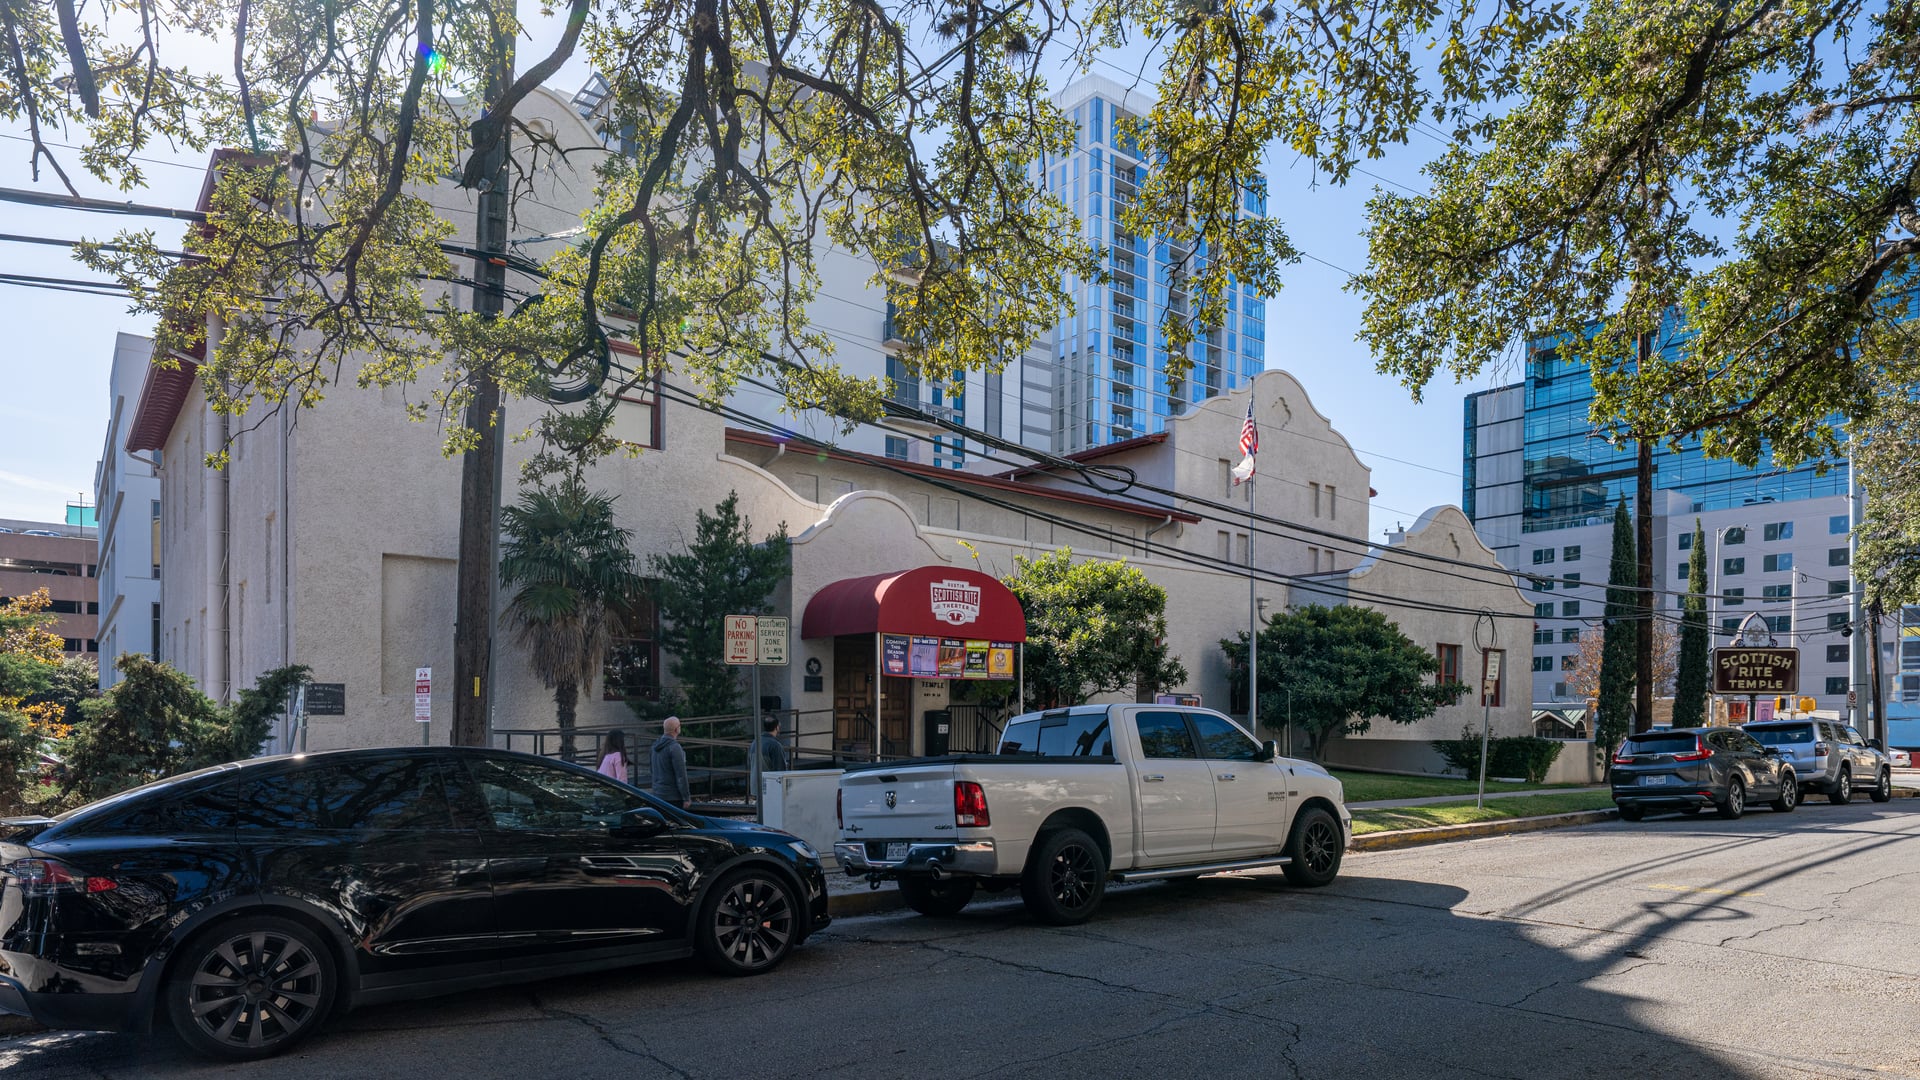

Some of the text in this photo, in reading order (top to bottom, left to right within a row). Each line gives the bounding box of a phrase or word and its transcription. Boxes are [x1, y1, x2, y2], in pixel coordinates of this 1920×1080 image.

[933, 588, 978, 605] SCOTTISH RITE
[735, 620, 747, 630] NO
[759, 620, 786, 628] CUSTOMER
[727, 630, 755, 641] PARKING
[764, 638, 781, 646] ZONE
[733, 647, 749, 655] TIME
[1721, 653, 1792, 669] SCOTTISH
[1739, 667, 1772, 676] RITE
[921, 681, 945, 689] TEMPLE
[1728, 680, 1782, 688] TEMPLE
